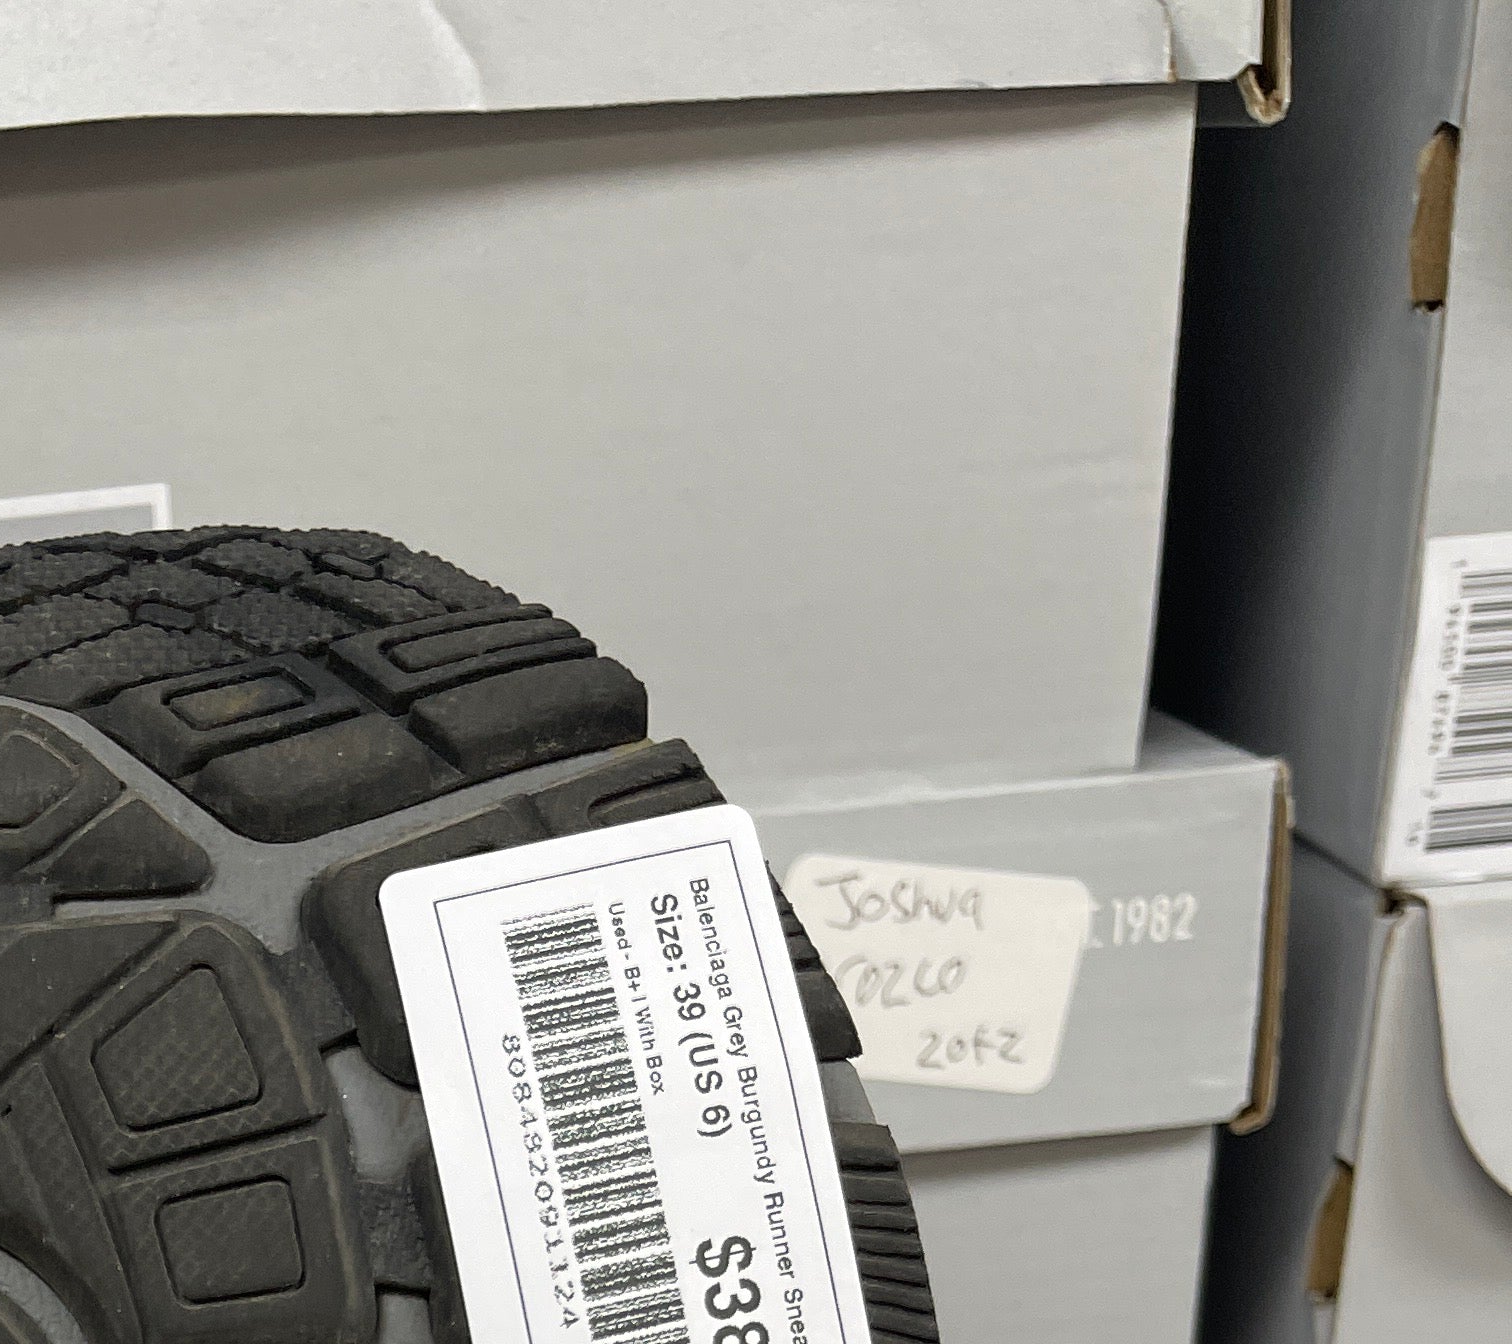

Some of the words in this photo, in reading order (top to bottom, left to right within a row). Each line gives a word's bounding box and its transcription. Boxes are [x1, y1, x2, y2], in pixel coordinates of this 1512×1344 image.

[607, 902, 633, 951] Used
[650, 893, 688, 973] Size:
[624, 966, 641, 992] B+
[672, 982, 707, 1022] 39
[634, 1005, 657, 1051] With
[645, 1055, 665, 1096] Box
[677, 1031, 724, 1094] (US
[689, 877, 734, 1001] Balenciaga
[722, 1005, 750, 1062] Grey
[737, 1067, 777, 1186] Burgundy
[763, 1190, 797, 1280] Runner
[696, 1104, 733, 1138] 6)
